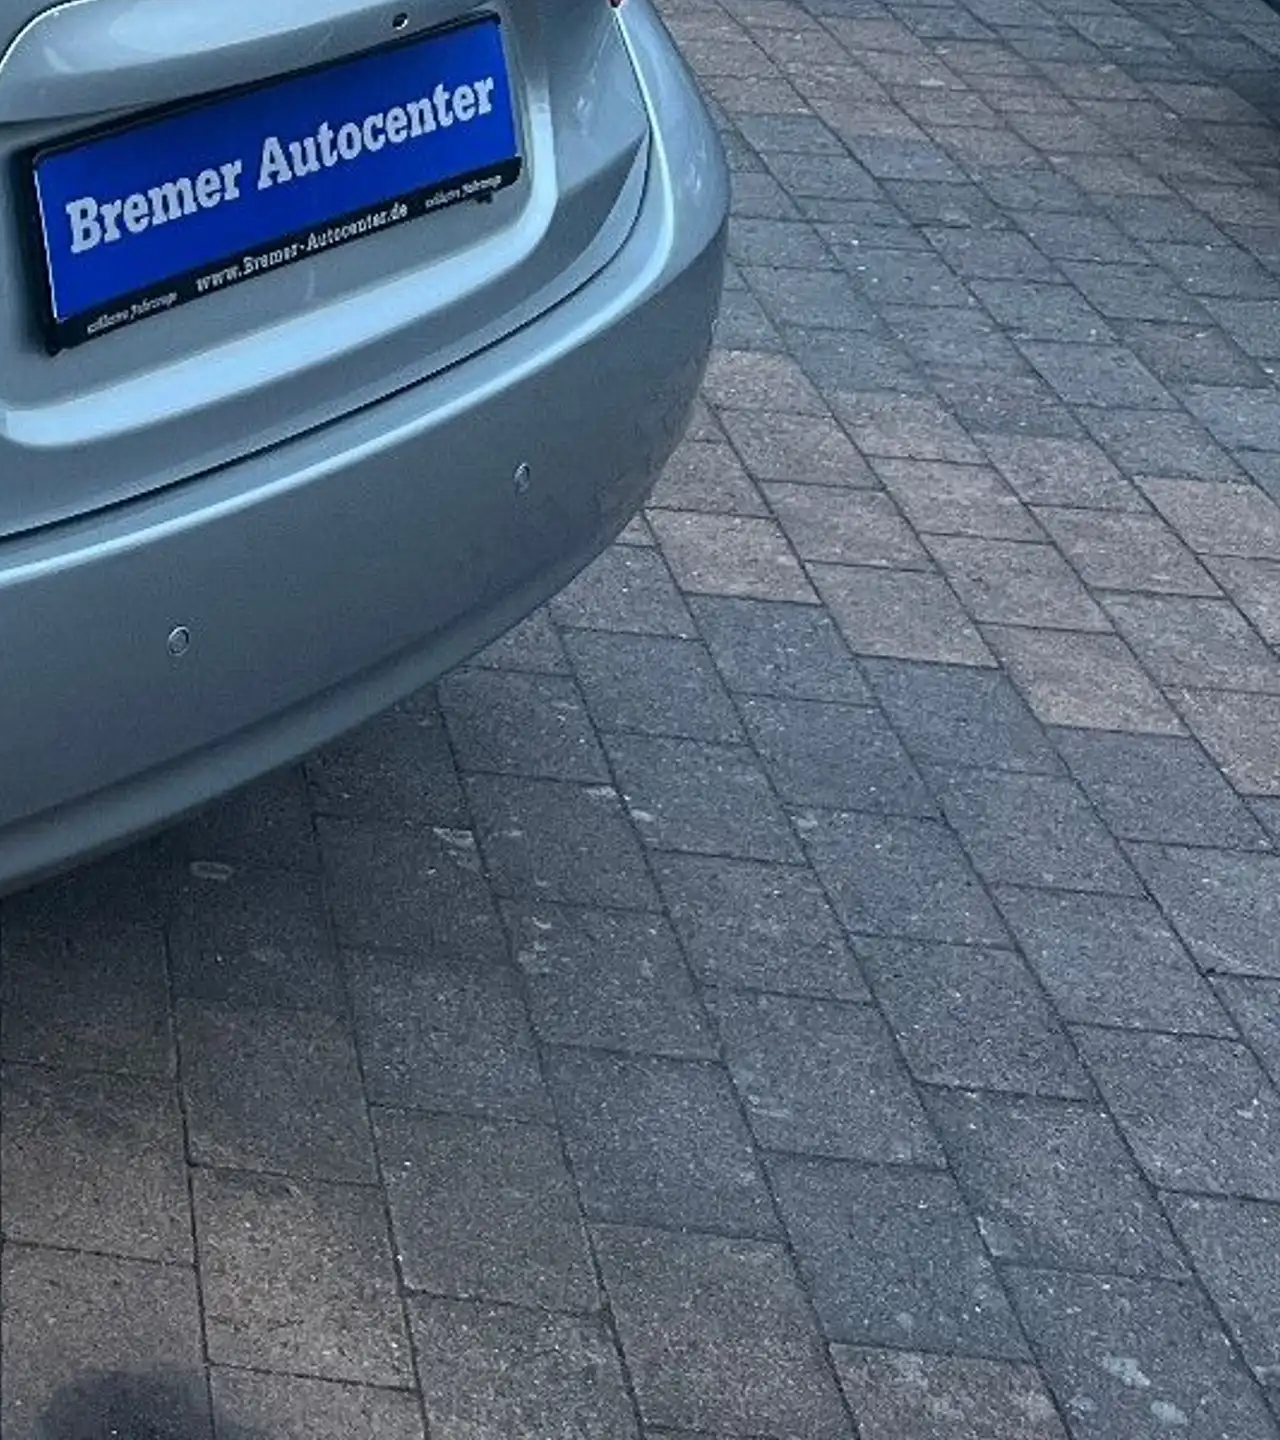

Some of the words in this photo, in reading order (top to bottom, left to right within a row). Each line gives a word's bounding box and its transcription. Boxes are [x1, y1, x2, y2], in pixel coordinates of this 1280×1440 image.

[65, 158, 243, 254] Bremer
[257, 76, 494, 191] Autocenter
[196, 201, 409, 293] www.Bremer-Autocenter.de
